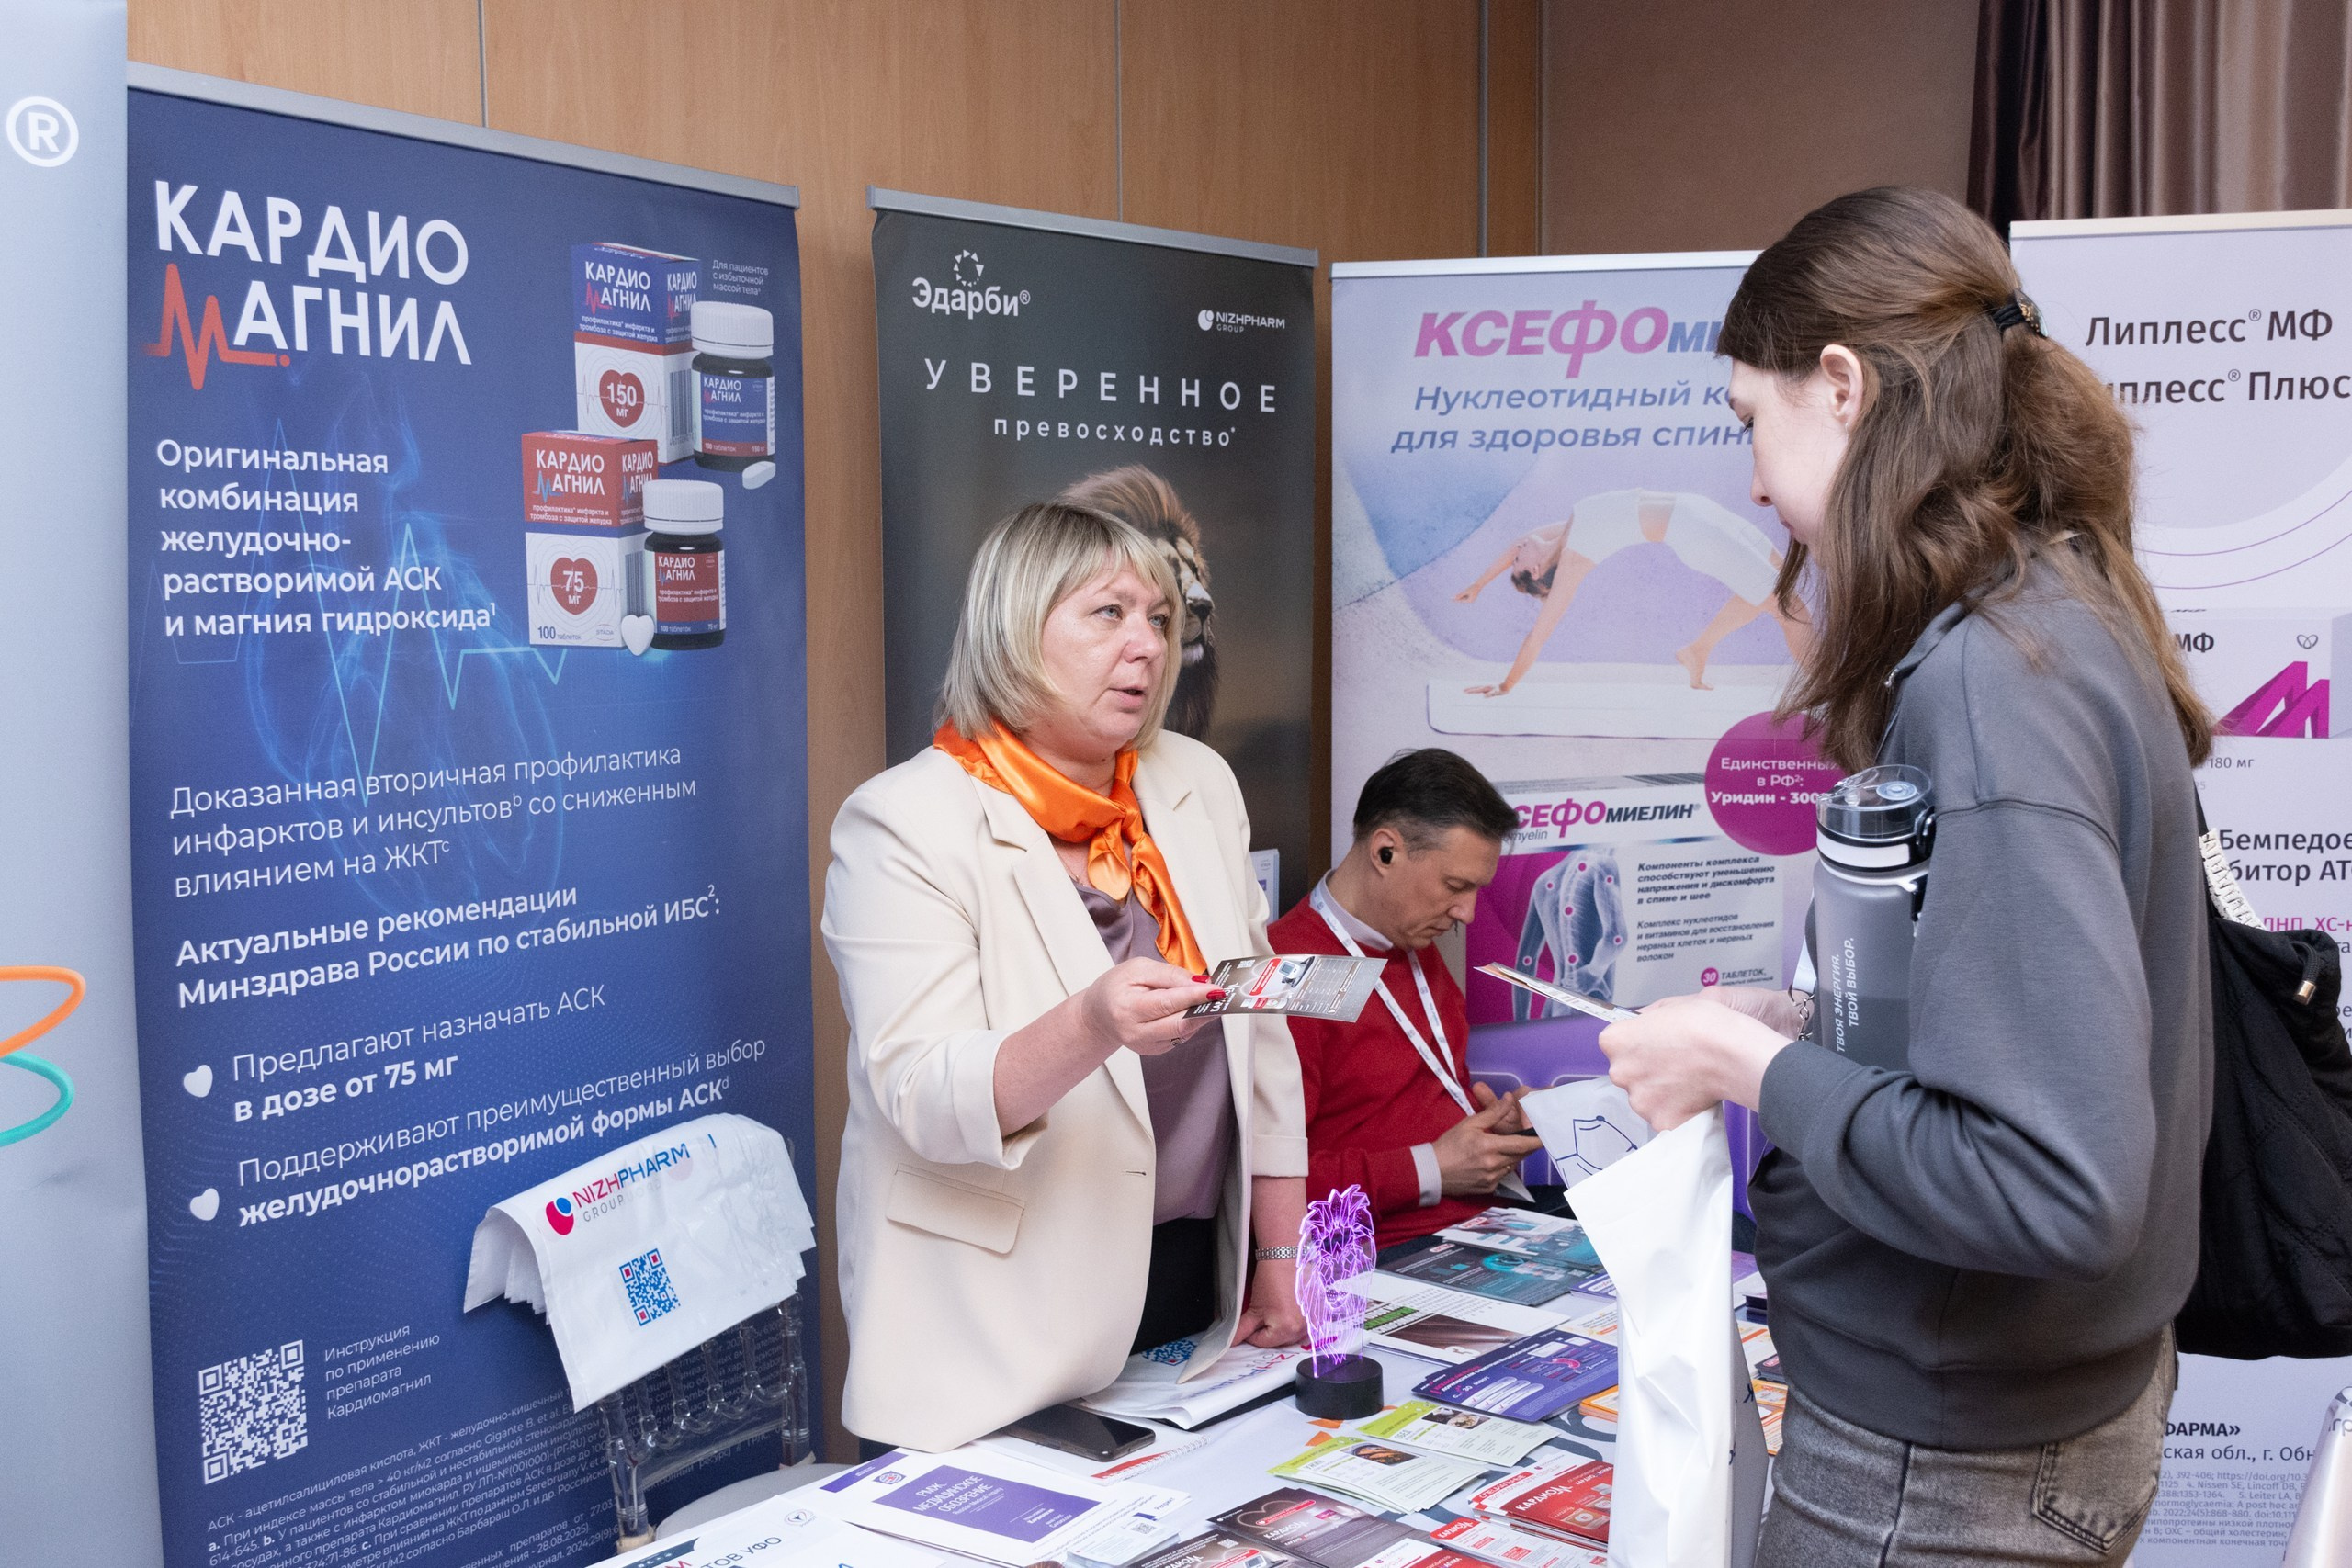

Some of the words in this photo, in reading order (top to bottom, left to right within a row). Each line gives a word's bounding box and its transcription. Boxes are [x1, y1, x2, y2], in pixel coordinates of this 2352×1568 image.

[155, 179, 469, 286] КАРДИО
[585, 261, 650, 290] КАРДИО
[713, 260, 728, 270] Для
[729, 264, 768, 276] пациентов
[719, 272, 763, 285] избыточной
[713, 284, 741, 293] массой
[1216, 311, 1286, 330] NIZHPHARM
[1216, 324, 1245, 333] GROUP
[2267, 309, 2333, 342] МФ
[606, 382, 637, 407] 150
[704, 377, 741, 390] КАРДИО
[924, 357, 1277, 413] УВЕРЕННОЕ
[1414, 379, 1691, 416] Нуклеотидный
[2107, 368, 2241, 404] плесс®
[2249, 371, 2351, 401] Плюс
[1390, 429, 1458, 454] для
[1467, 426, 1642, 454] здоровья
[156, 438, 389, 474] Оригинальная
[536, 449, 605, 473] КАРДИО
[160, 482, 358, 515] комбинация
[161, 530, 351, 558] желудочно-
[658, 556, 695, 570] КАРДИО
[164, 566, 375, 600] растворимой
[383, 566, 442, 592] АСК
[562, 570, 584, 593] 75
[568, 594, 581, 605] мг
[165, 616, 184, 637] и
[195, 612, 311, 636] магния
[537, 626, 556, 640] 100
[2175, 632, 2215, 653] МФ
[2209, 757, 2232, 769] 180
[2236, 757, 2255, 768] мг
[169, 777, 356, 819] Доказанная
[365, 761, 506, 797] вторичная
[514, 745, 682, 783] профилактика
[1757, 777, 1766, 786] в
[1711, 792, 1775, 806] Уридин
[172, 820, 344, 858] инфарктов
[352, 816, 369, 838] и
[528, 794, 557, 816] со
[561, 778, 697, 812] сниженным
[175, 860, 334, 898] влиянием
[343, 852, 377, 876] на
[1637, 861, 1702, 872] Компоненты
[1706, 856, 1760, 866] комплекса
[1637, 871, 1710, 883] способствуют
[1712, 865, 1775, 877] уменьшению
[2319, 860, 2352, 881] АТ
[1637, 882, 1699, 894] напряжения
[1710, 875, 1775, 889] дискомфорта
[1646, 895, 1678, 904] спине
[1690, 892, 1711, 900] шее
[175, 917, 369, 967] Актуальные
[378, 885, 578, 940] рекомендации
[1637, 919, 1681, 929] Комплекс
[1683, 913, 1738, 926] нуклеотидов
[1645, 929, 1690, 940] витаминов
[1691, 928, 1707, 937] для
[1709, 920, 1775, 933] восстановления
[178, 959, 360, 1009] Минздрава
[368, 939, 470, 976] России
[477, 931, 510, 957] по
[516, 902, 658, 949] стабильной
[1637, 942, 1675, 953] нервных
[1677, 938, 1707, 947] клеток
[1716, 933, 1753, 944] нервных
[1637, 952, 1674, 963] волокон
[1844, 937, 1857, 988] ВЫБОР.
[1703, 972, 1716, 983] 30
[1831, 953, 1843, 1017] ЭНЕРГИЯ.
[1845, 992, 1859, 1028] ТВОЙ
[232, 1028, 416, 1083] Предлагают
[421, 997, 552, 1043] назначать
[557, 983, 606, 1017] АСК
[1836, 1020, 1845, 1052] ТВОЯ
[233, 1100, 254, 1122] в
[261, 1080, 338, 1121] дозе
[345, 1070, 379, 1099] от
[384, 1061, 418, 1089] 75
[424, 1052, 460, 1080] мг
[238, 1113, 460, 1189] Поддерживают
[466, 1051, 702, 1134] преимущественный
[706, 1036, 767, 1070] выбор
[238, 1118, 586, 1229] желудочнорастворимой
[591, 1098, 674, 1136] формы
[572, 1141, 690, 1209] NIZHPHARM
[582, 1194, 625, 1223] GROUP
[324, 1325, 411, 1362] Инструкция
[326, 1366, 344, 1382] по
[347, 1334, 440, 1376] применению
[326, 1365, 402, 1402] препарата
[327, 1373, 432, 1420] Кардиомагнил
[208, 1513, 235, 1532] АСК
[245, 1463, 368, 1519] ацетилсалициловая
[369, 1450, 416, 1472] кислота,
[418, 1435, 442, 1452] ЖКТ
[450, 1389, 564, 1440] желудочно-кишечный
[2211, 1445, 2256, 1463] обл.,
[2263, 1449, 2274, 1461] г.
[254, 1508, 306, 1535] индексе
[310, 1492, 346, 1514] массы
[435, 1440, 482, 1464] согласно
[289, 1504, 354, 1536] пациентов
[372, 1470, 437, 1504] стабильной
[343, 1497, 407, 1529] инфарктом
[458, 1510, 510, 1539] Барбараш
